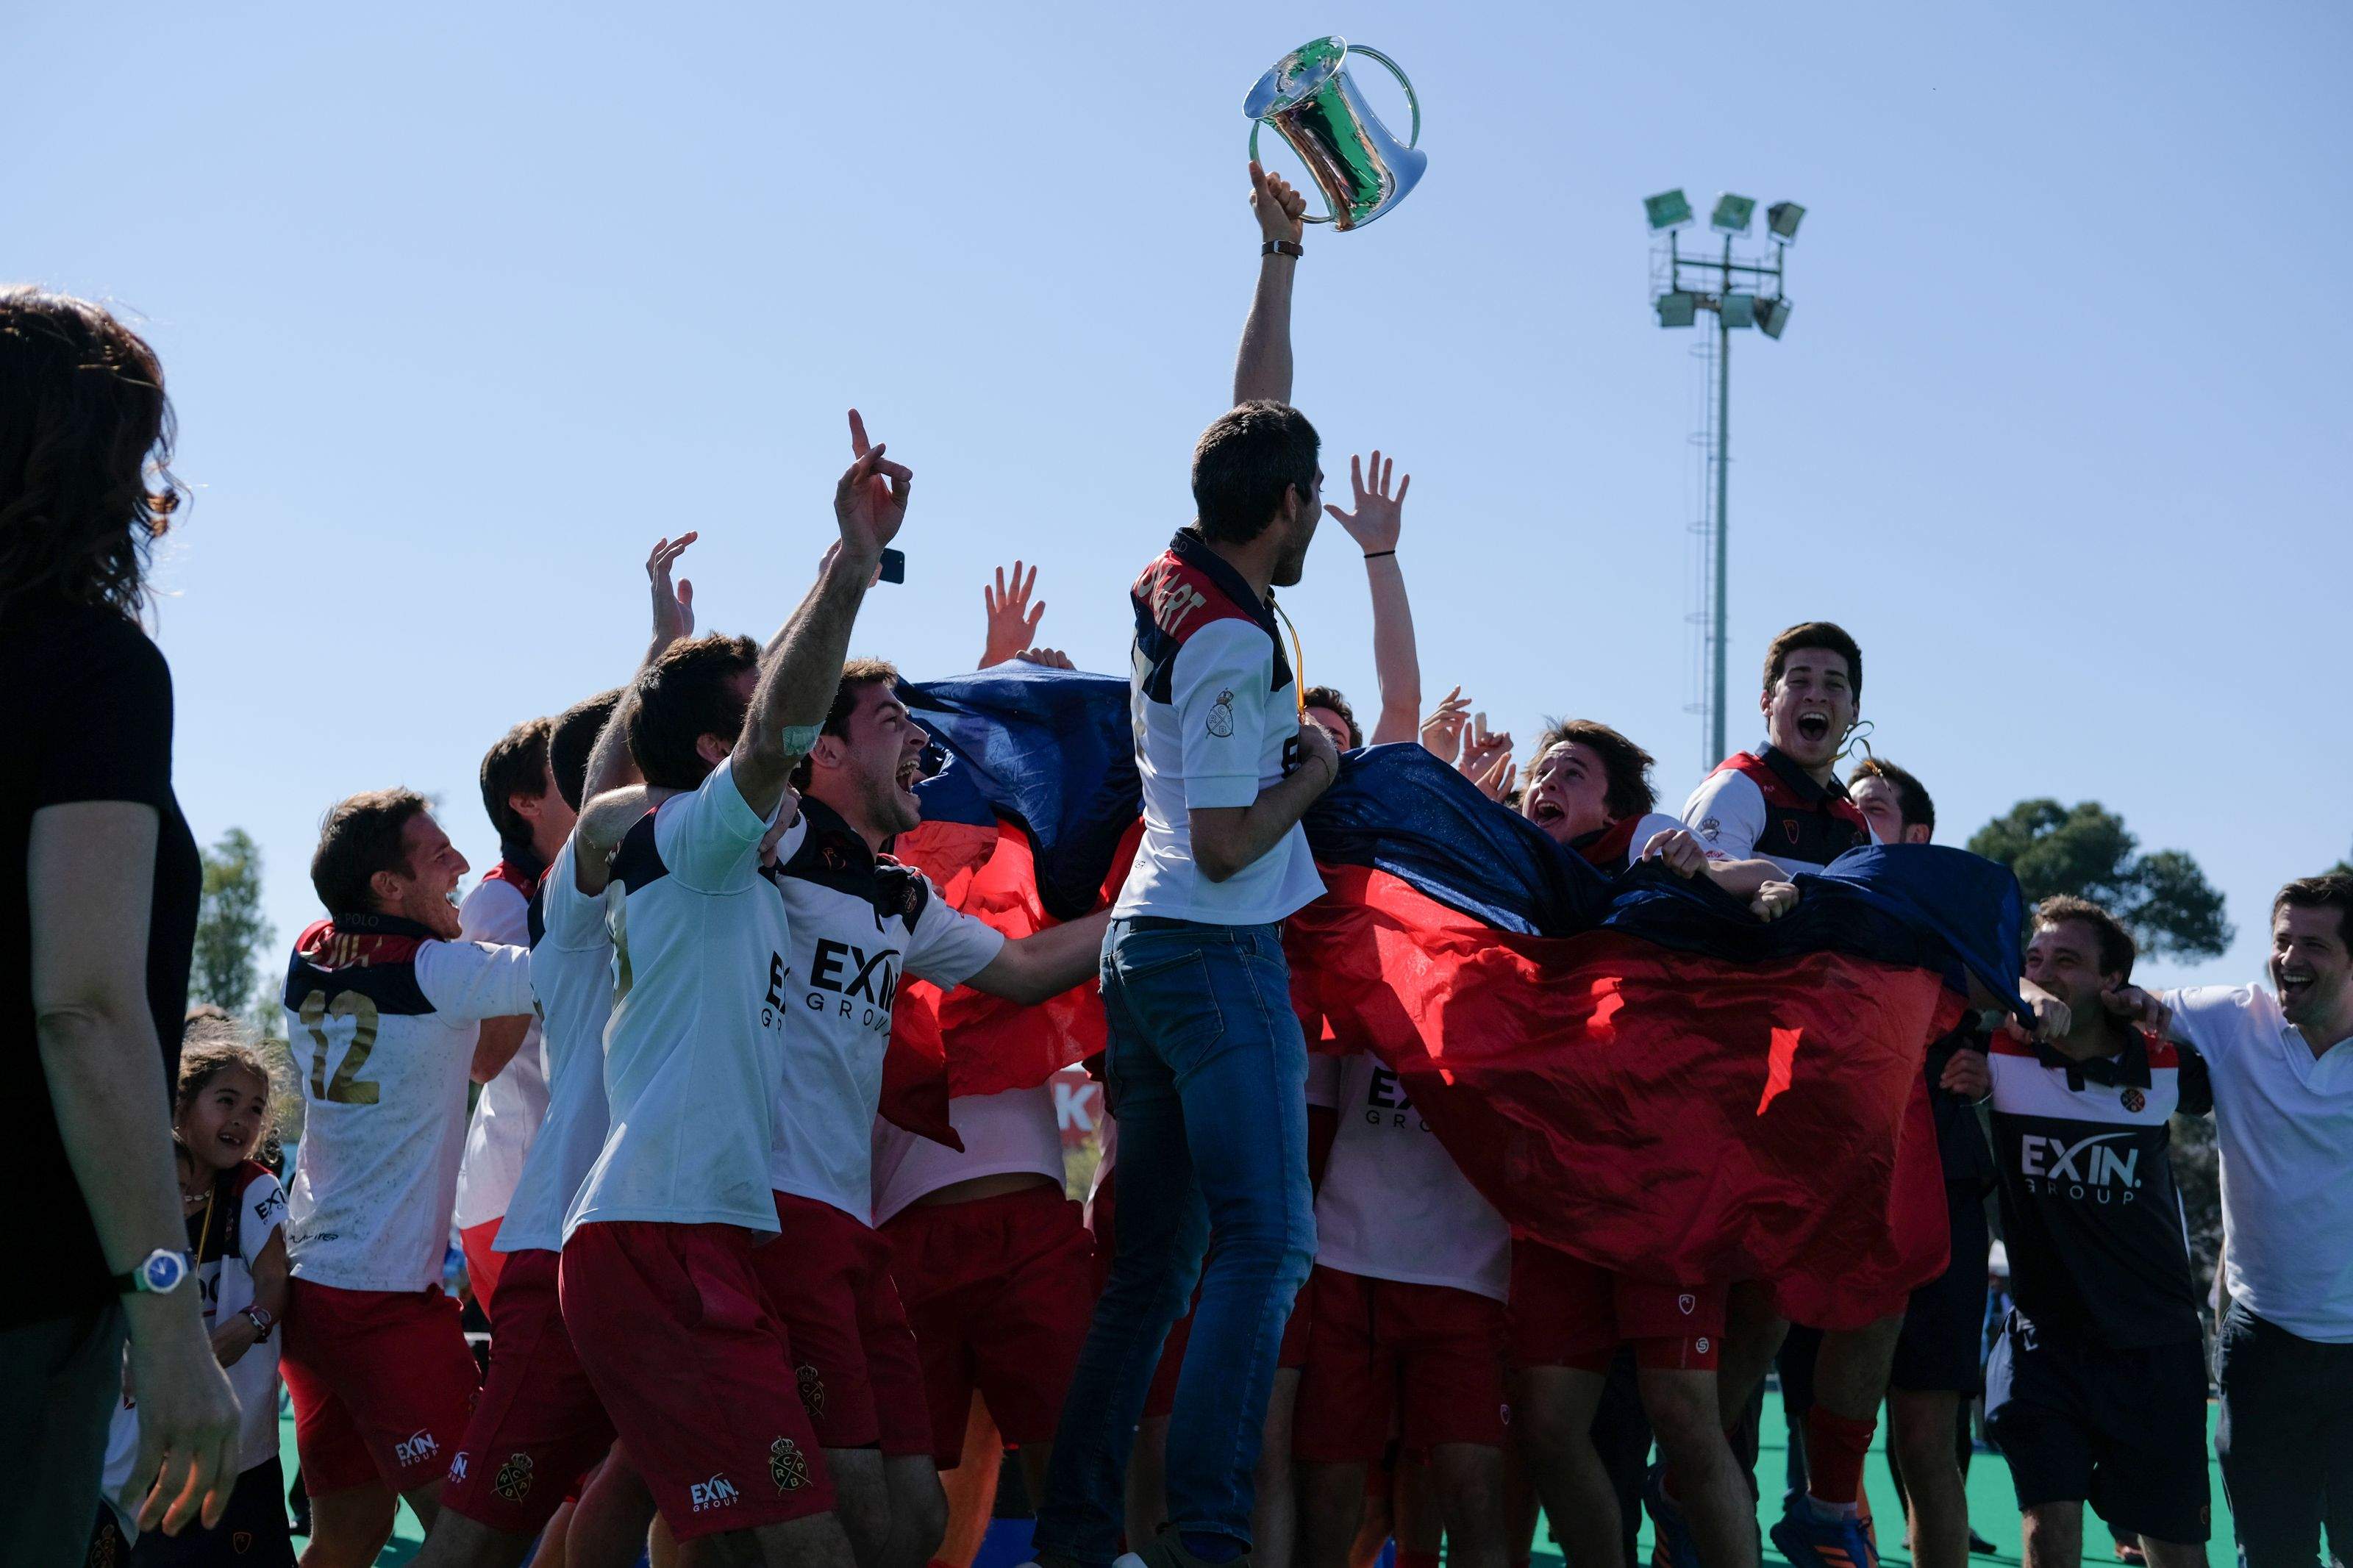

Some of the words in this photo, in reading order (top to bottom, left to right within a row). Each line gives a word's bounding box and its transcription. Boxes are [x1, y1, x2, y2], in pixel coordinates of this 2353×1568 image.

[345, 912, 379, 927] POLO
[299, 989, 380, 1104] 12
[2024, 1178, 2135, 1206] GROUP
[693, 1495, 738, 1512] GROUP
